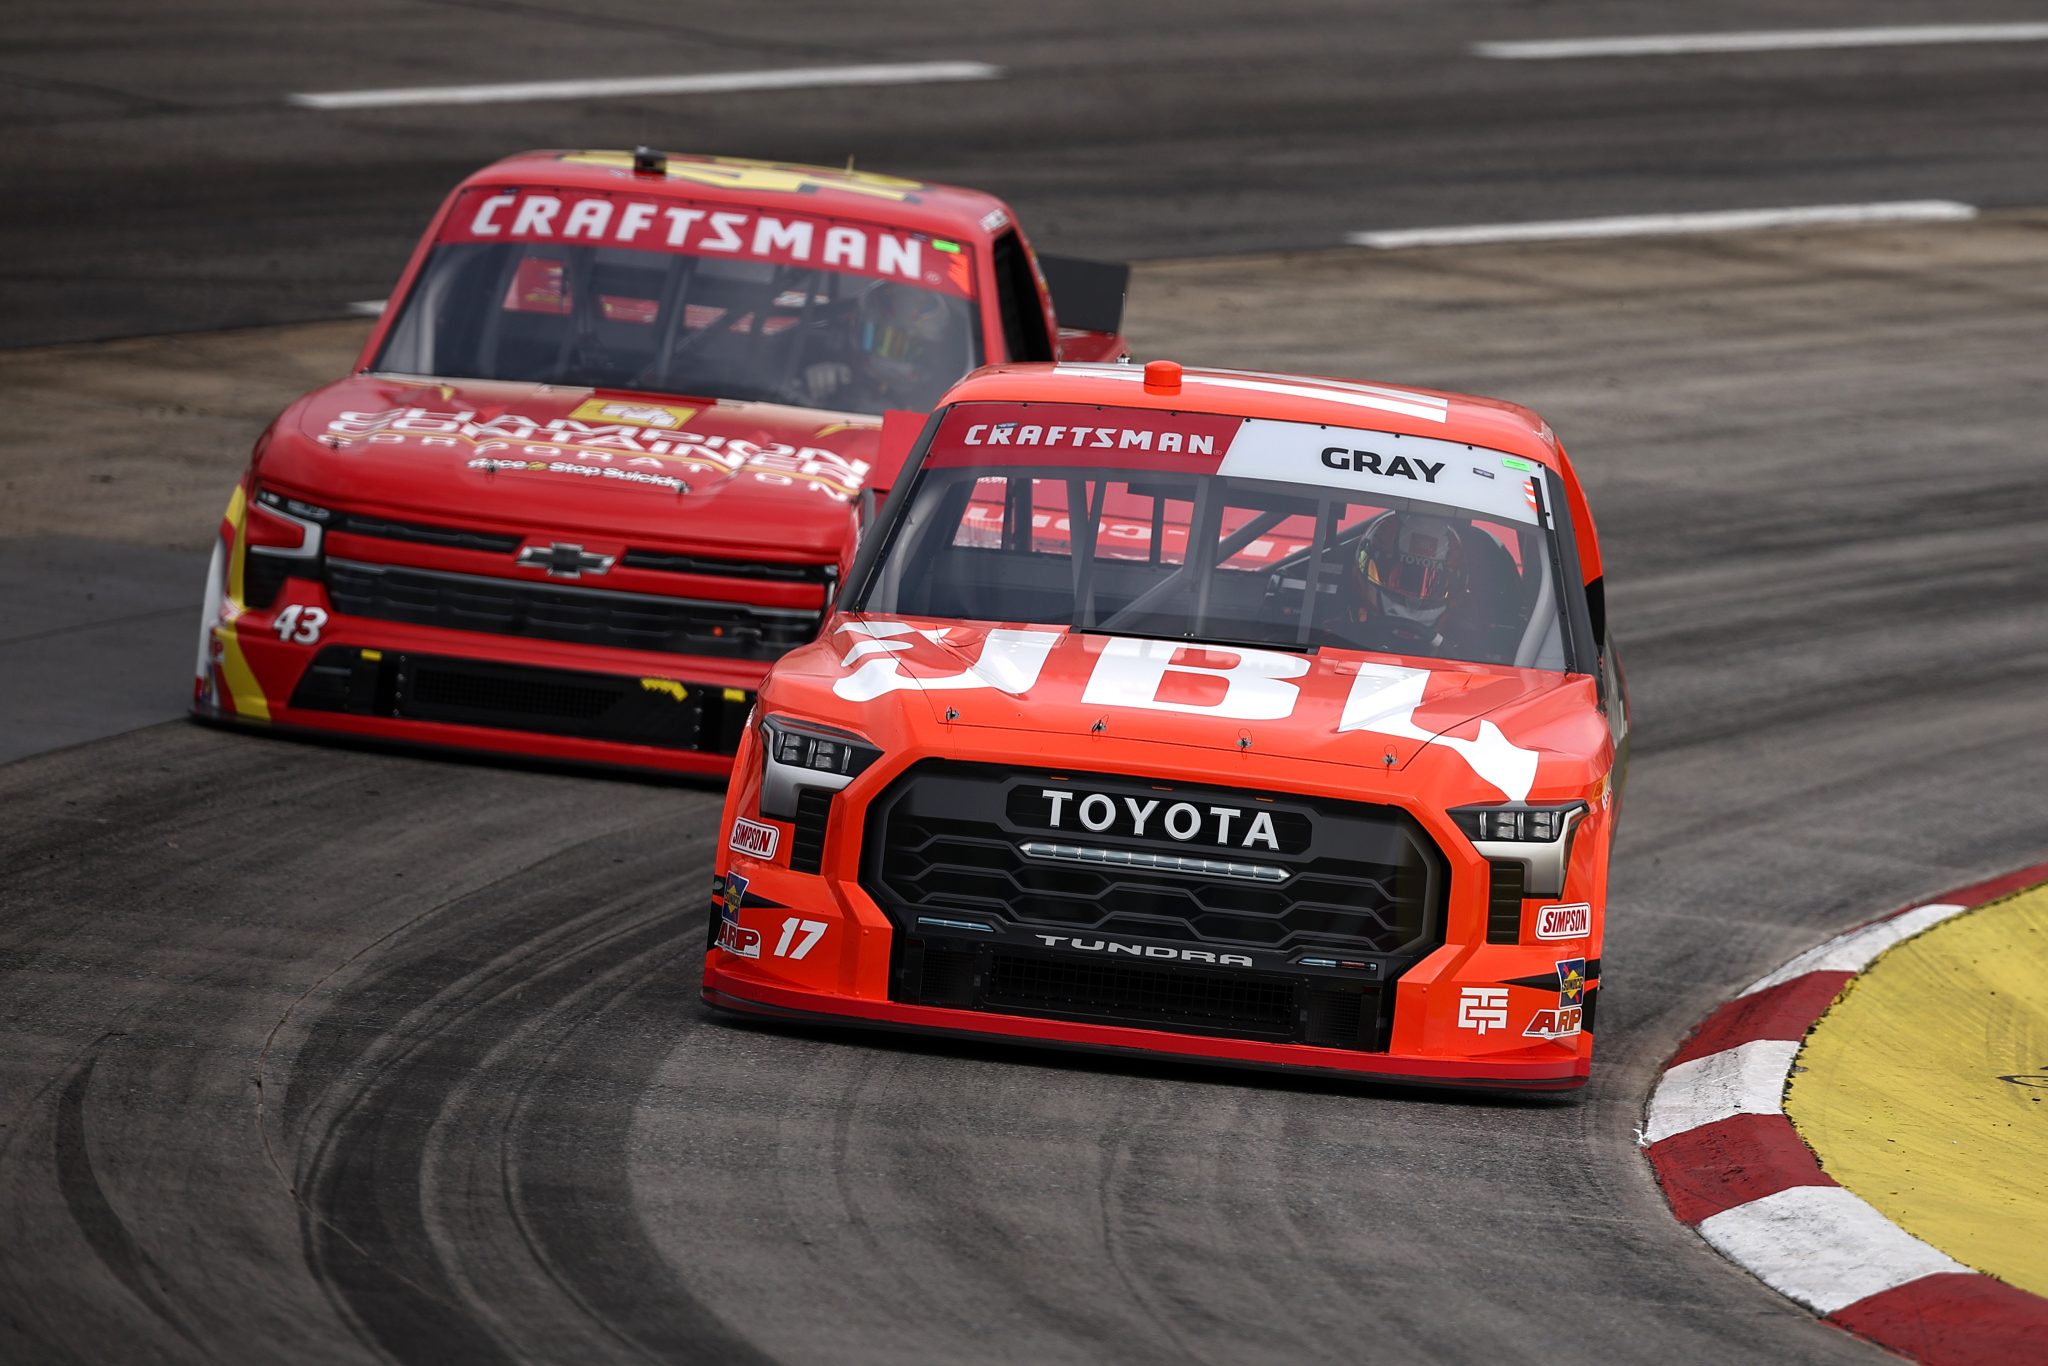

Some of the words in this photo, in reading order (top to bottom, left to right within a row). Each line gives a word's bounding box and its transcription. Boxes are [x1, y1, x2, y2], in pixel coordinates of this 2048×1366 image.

[470, 195, 920, 280] CRAFTSMAN
[340, 408, 870, 478] CHAMPION
[964, 424, 1214, 455] CRAFTSMAN
[548, 461, 602, 477] Stop
[1321, 447, 1446, 484] GRAY
[1400, 554, 1444, 570] TOYOTA
[273, 604, 328, 644] 43
[833, 620, 1540, 802] JBL
[1042, 789, 1280, 851] TOYOTA
[732, 823, 772, 853] SIMPSON
[718, 921, 760, 951] ARP
[1542, 908, 1588, 934] SIMPSON
[773, 917, 829, 960] 17
[1035, 934, 1253, 967] TUNDRA
[1527, 1008, 1582, 1034] ARP
